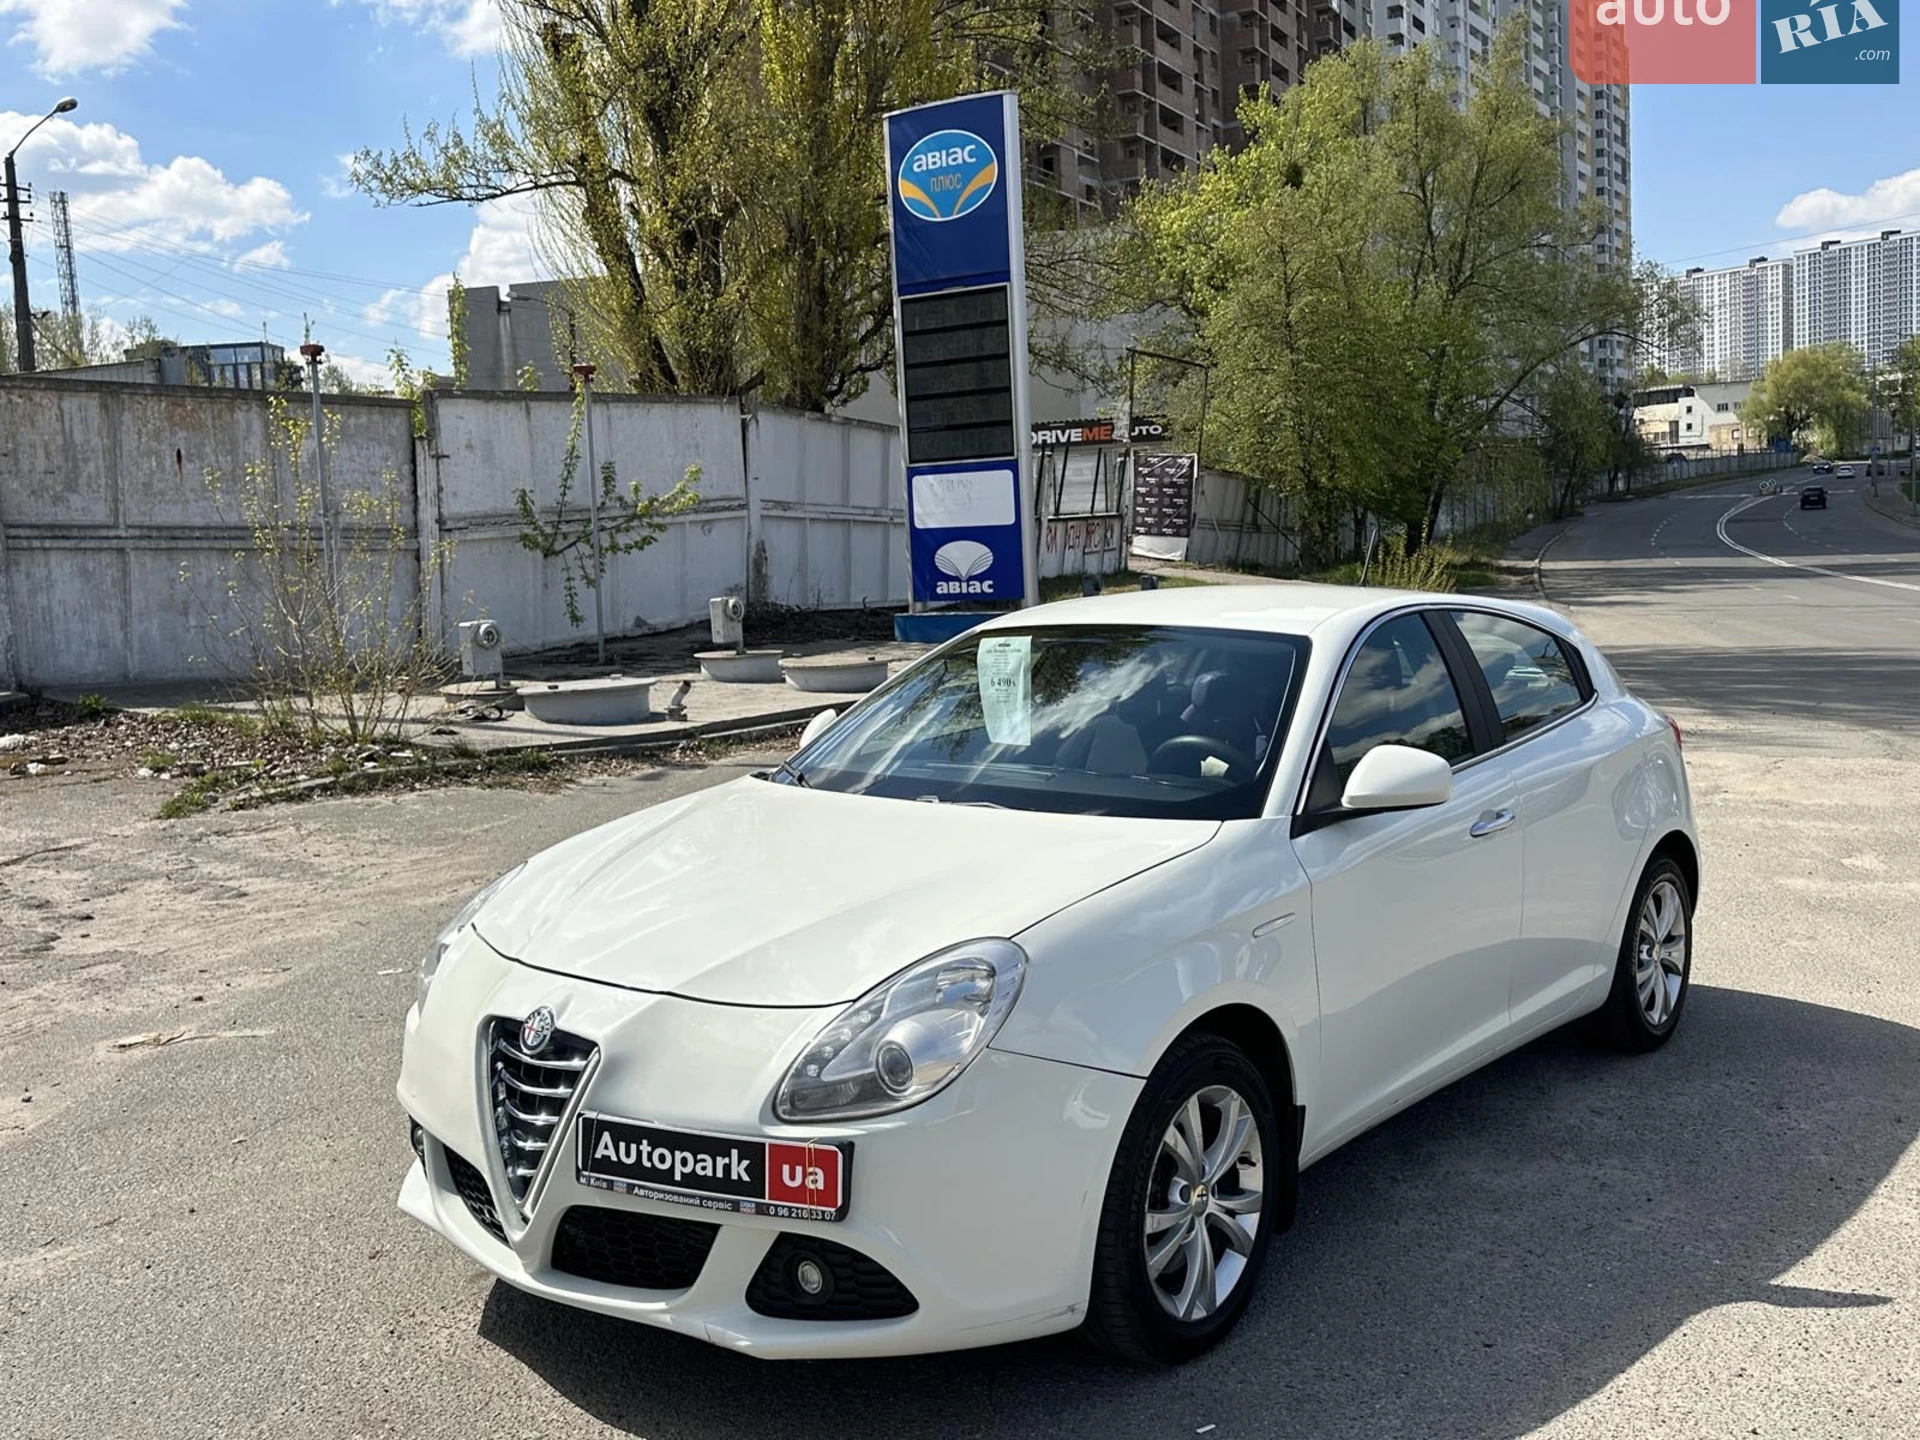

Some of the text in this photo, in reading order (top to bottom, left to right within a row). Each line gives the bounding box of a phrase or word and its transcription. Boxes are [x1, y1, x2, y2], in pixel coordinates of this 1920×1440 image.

[1131, 424, 1163, 437] UTO
[594, 1130, 825, 1191] Autopark ua
[633, 1186, 701, 1206] Авторизований
[702, 1199, 733, 1211] сервіс
[769, 1205, 836, 1220] 0 96 216 33 07
